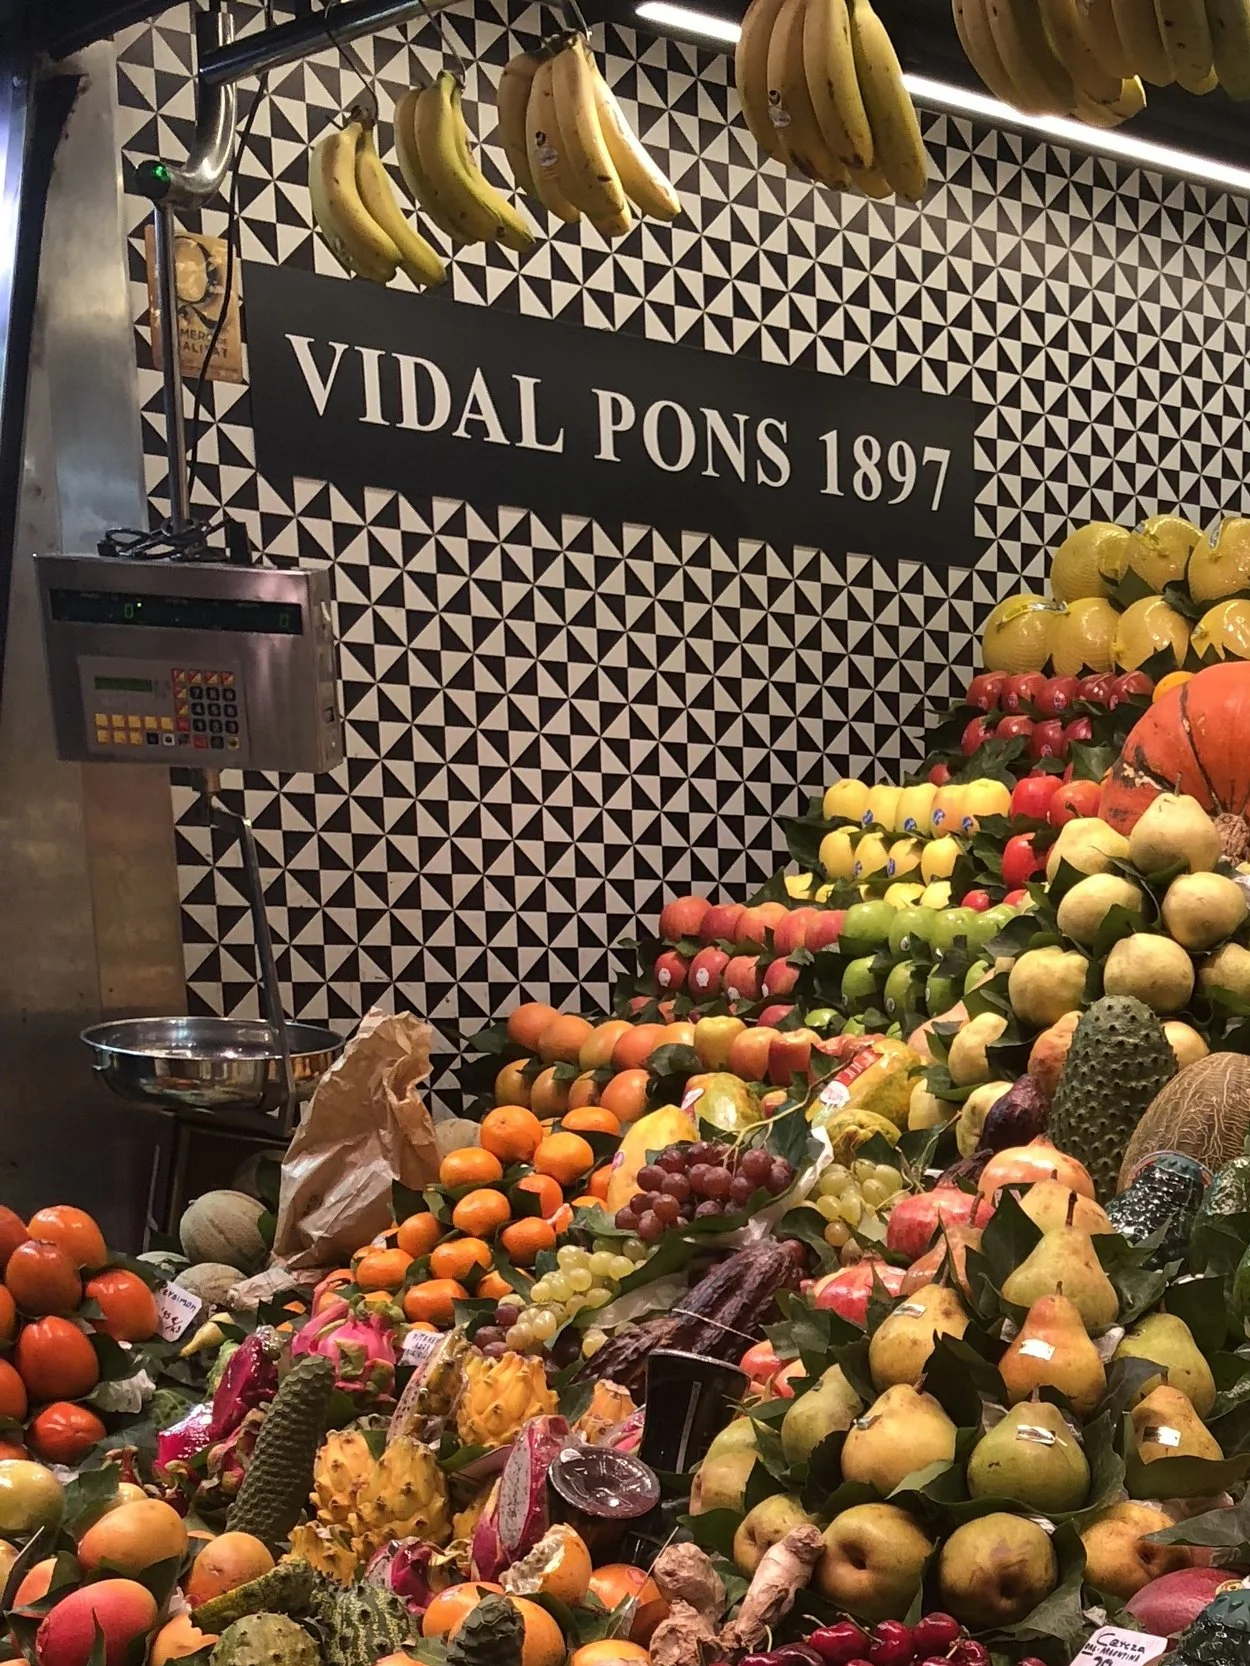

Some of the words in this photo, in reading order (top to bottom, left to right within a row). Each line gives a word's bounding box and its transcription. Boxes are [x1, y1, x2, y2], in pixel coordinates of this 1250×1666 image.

[284, 332, 565, 454] VIDAL
[590, 387, 793, 489] PONS
[818, 428, 952, 512] 1897
